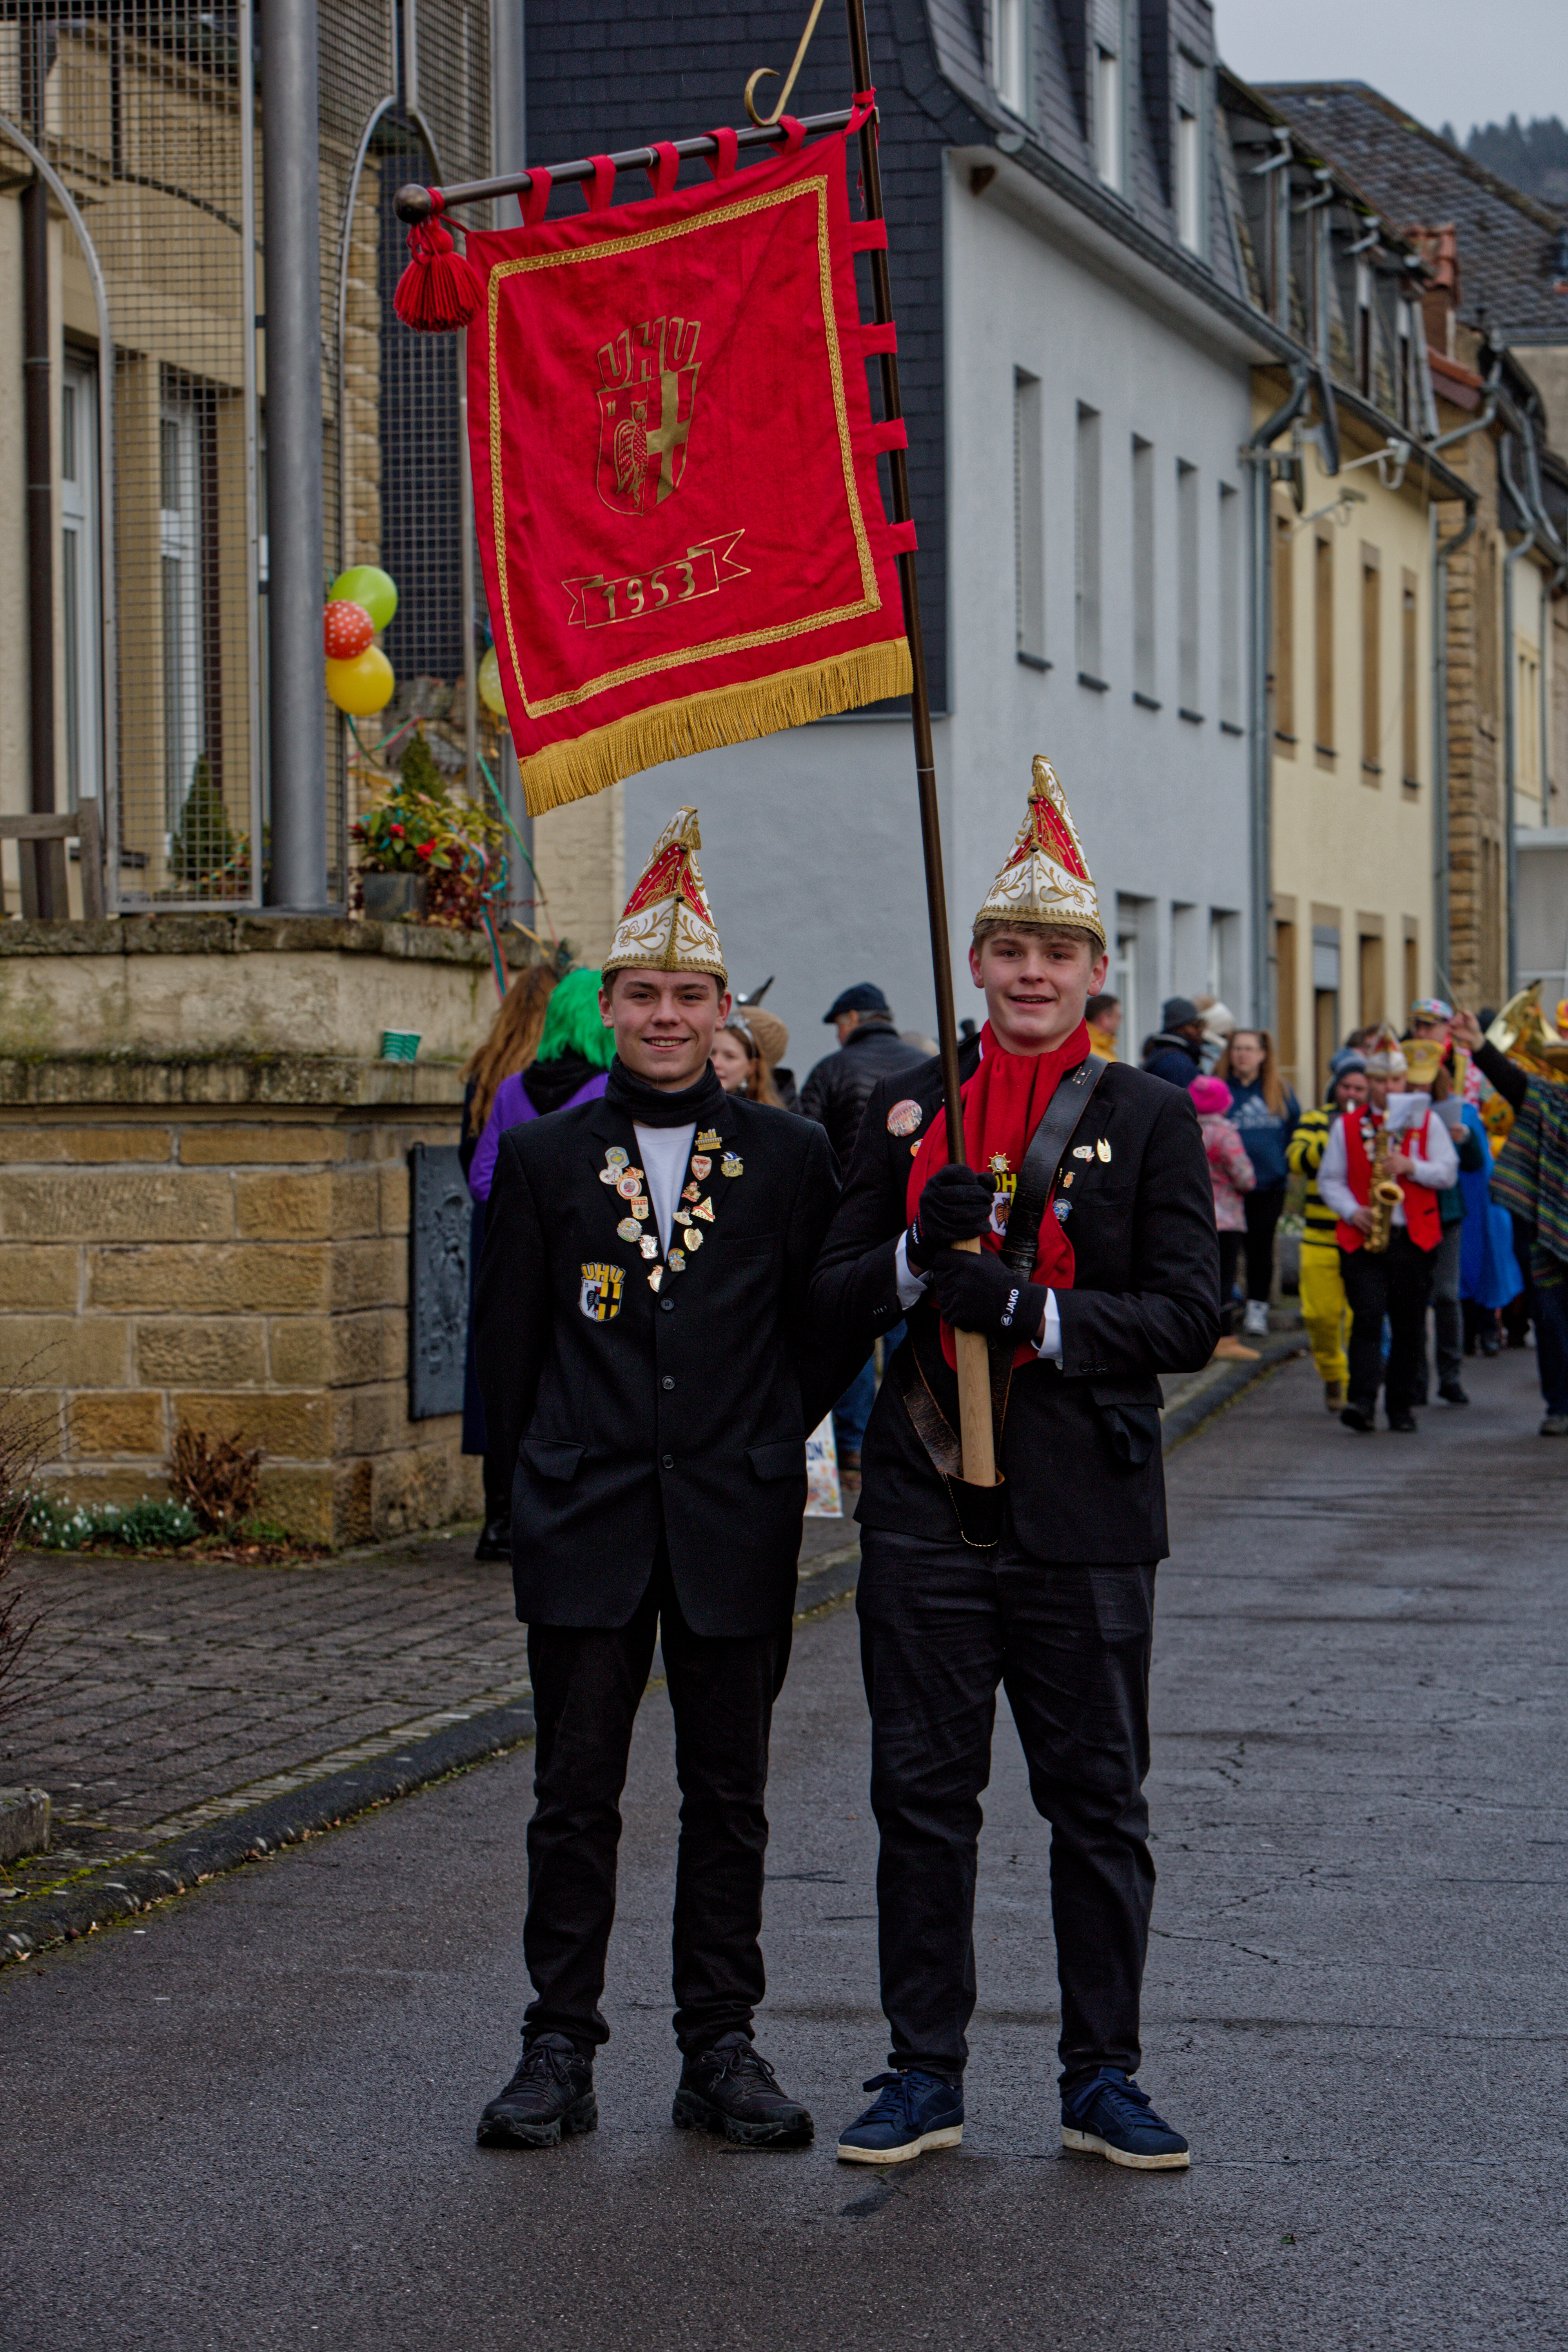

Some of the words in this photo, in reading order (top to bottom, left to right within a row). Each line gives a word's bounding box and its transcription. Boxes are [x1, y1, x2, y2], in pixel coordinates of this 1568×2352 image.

[597, 315, 701, 389] UHU
[602, 562, 695, 619] 1953
[581, 1263, 624, 1283] UHU
[1005, 1289, 1019, 1314] JAKO
